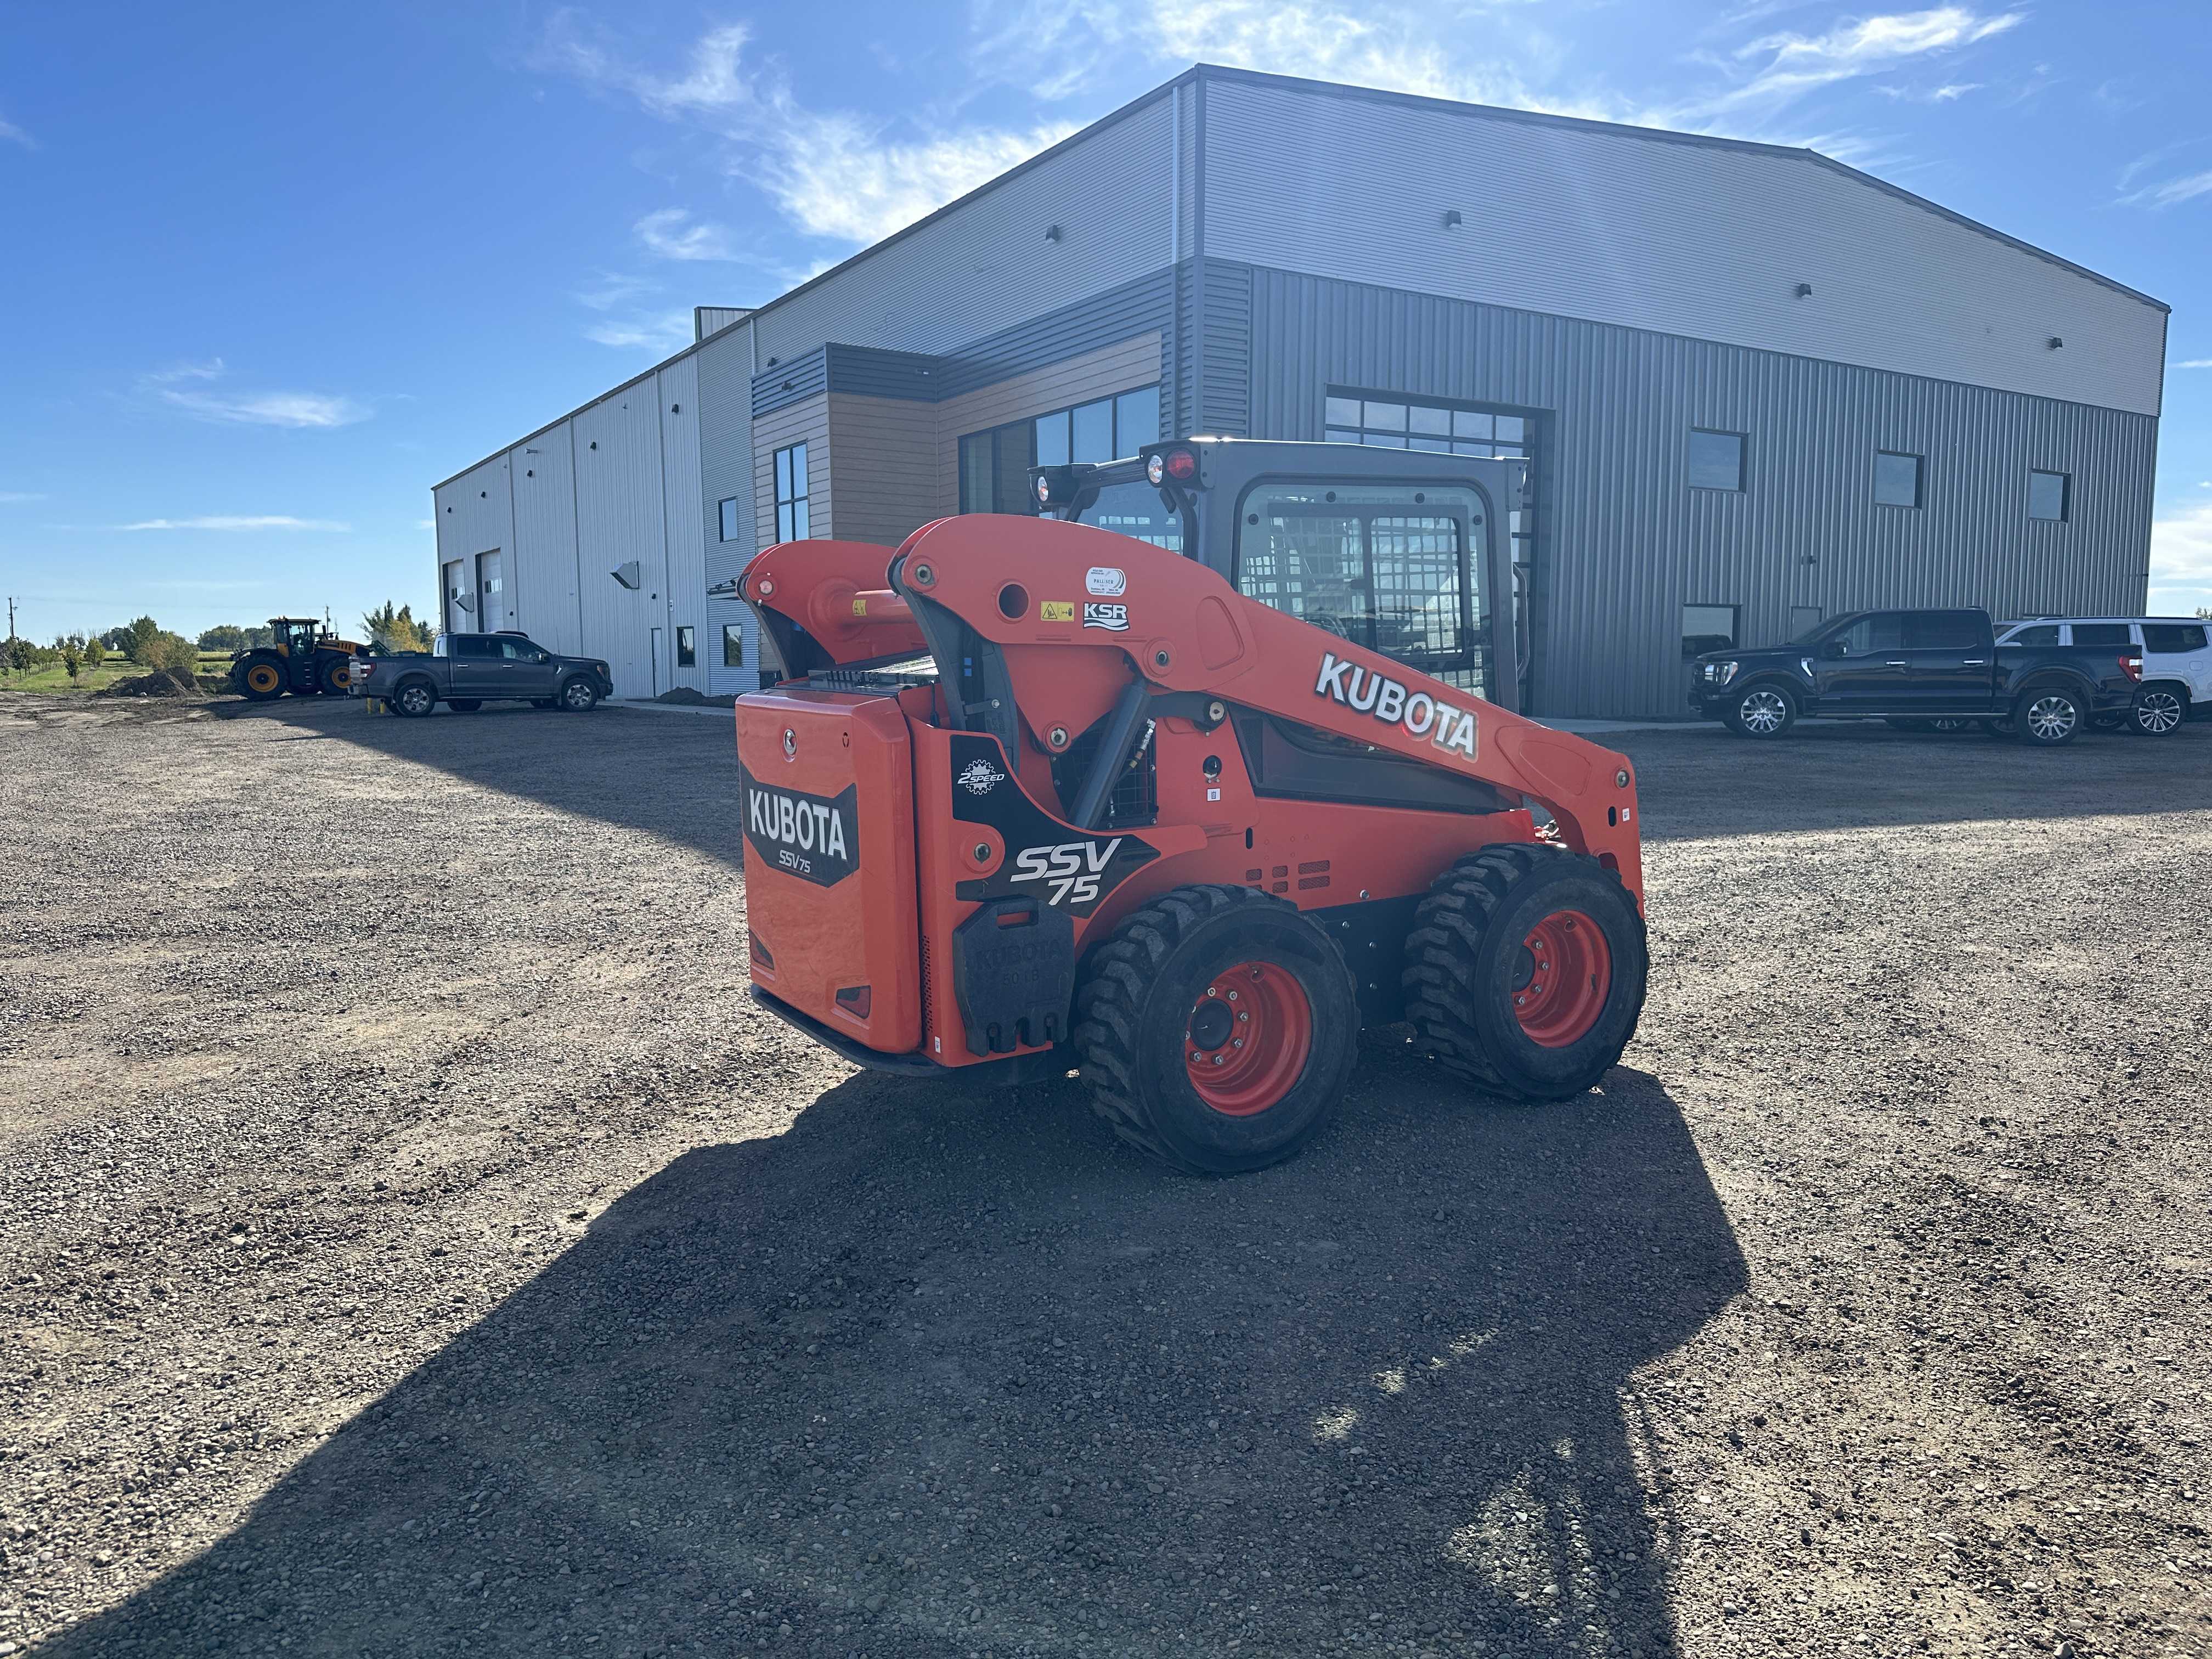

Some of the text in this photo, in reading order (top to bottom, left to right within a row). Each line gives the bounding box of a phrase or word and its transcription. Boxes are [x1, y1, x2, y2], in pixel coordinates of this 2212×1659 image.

[1084, 603, 1127, 619] KSR
[1315, 653, 1477, 755] KUBOTA
[749, 788, 848, 861] KUBOTA
[1010, 838, 1122, 882] SSV
[1047, 874, 1101, 906] 75
[976, 939, 1063, 970] KUBOTA
[1003, 969, 1040, 985] 50 LB
